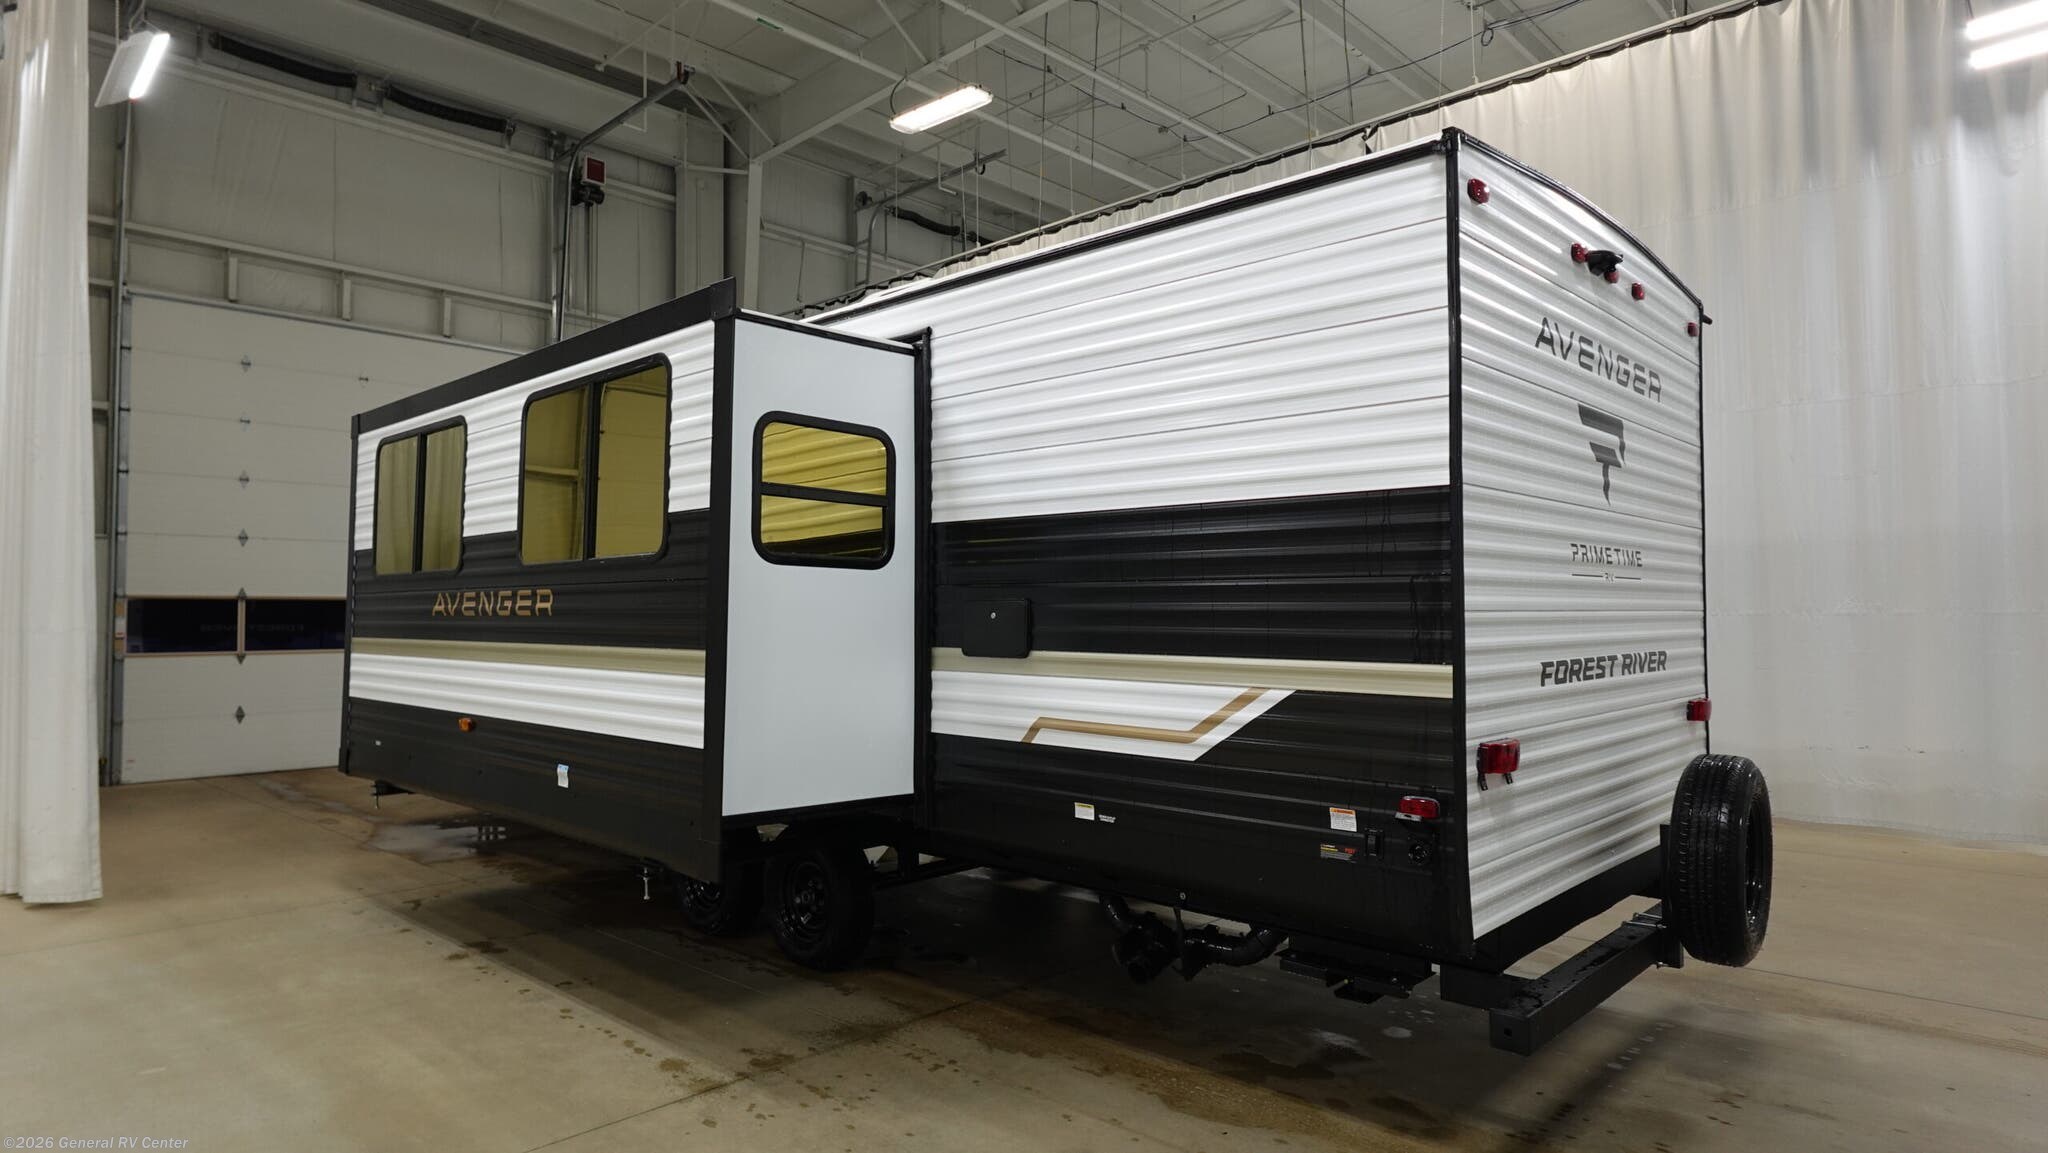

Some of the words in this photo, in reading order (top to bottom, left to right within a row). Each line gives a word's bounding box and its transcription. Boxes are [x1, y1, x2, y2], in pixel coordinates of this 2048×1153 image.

[1535, 317, 1661, 403] AVENGER
[432, 589, 554, 617] AVENGER
[1540, 654, 1619, 688] FOREST
[1621, 650, 1668, 676] RIVER
